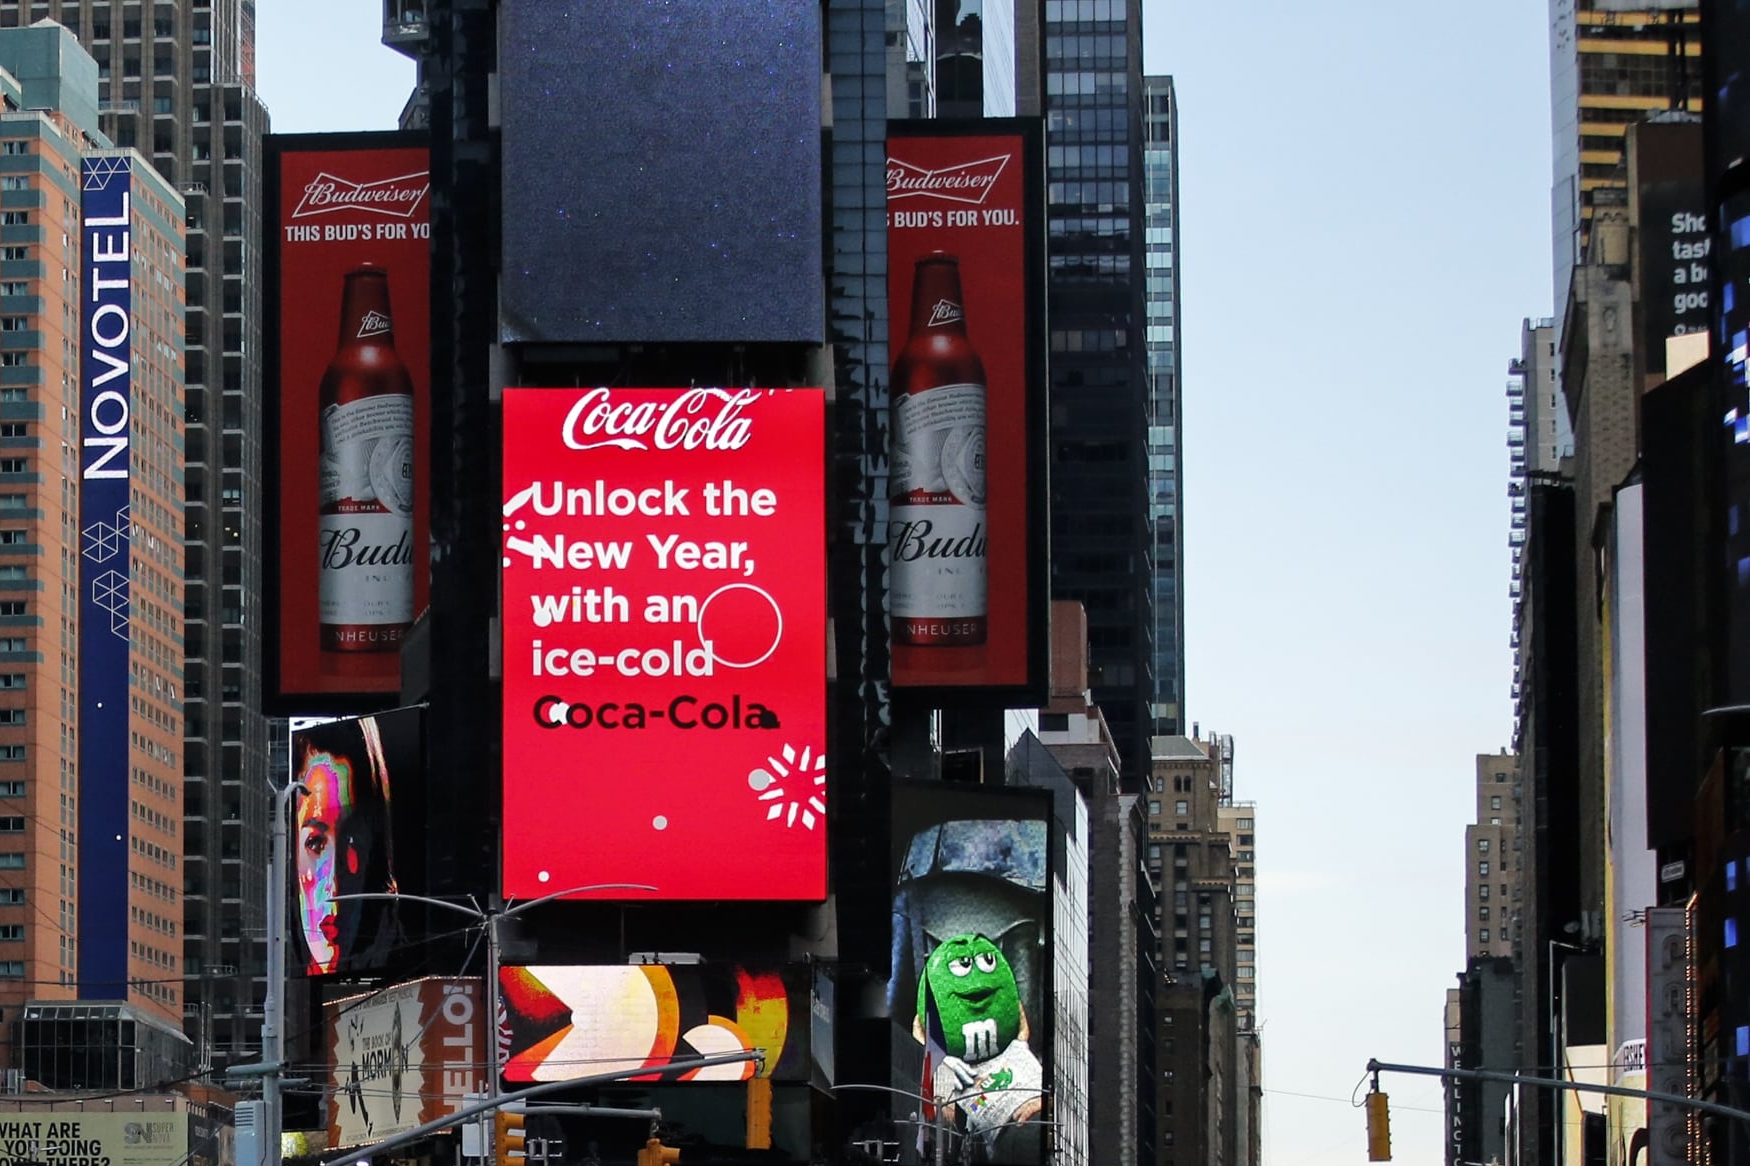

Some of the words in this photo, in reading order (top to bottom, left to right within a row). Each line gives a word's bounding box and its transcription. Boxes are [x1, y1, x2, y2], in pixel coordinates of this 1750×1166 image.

[304, 183, 424, 206] Budweiser
[285, 225, 320, 242] THIS
[325, 223, 372, 241] BUD'S
[376, 223, 406, 240] FOR
[411, 222, 430, 240] YO
[894, 211, 942, 228] BUD'S
[947, 210, 978, 226] FOR
[983, 208, 1019, 226] YOU.
[84, 191, 129, 480] NOVOTEL
[562, 387, 761, 451] Coca-Cola
[531, 479, 690, 516] Unlock
[703, 479, 777, 516] the
[532, 533, 633, 570] New
[646, 533, 755, 577] Year,
[531, 586, 629, 624] with
[644, 594, 698, 624] an
[532, 639, 714, 677] ice-cold
[533, 694, 775, 730] Coca-Cola
[46, 1139, 102, 1157] DOING
[47, 1122, 81, 1139] ARE
